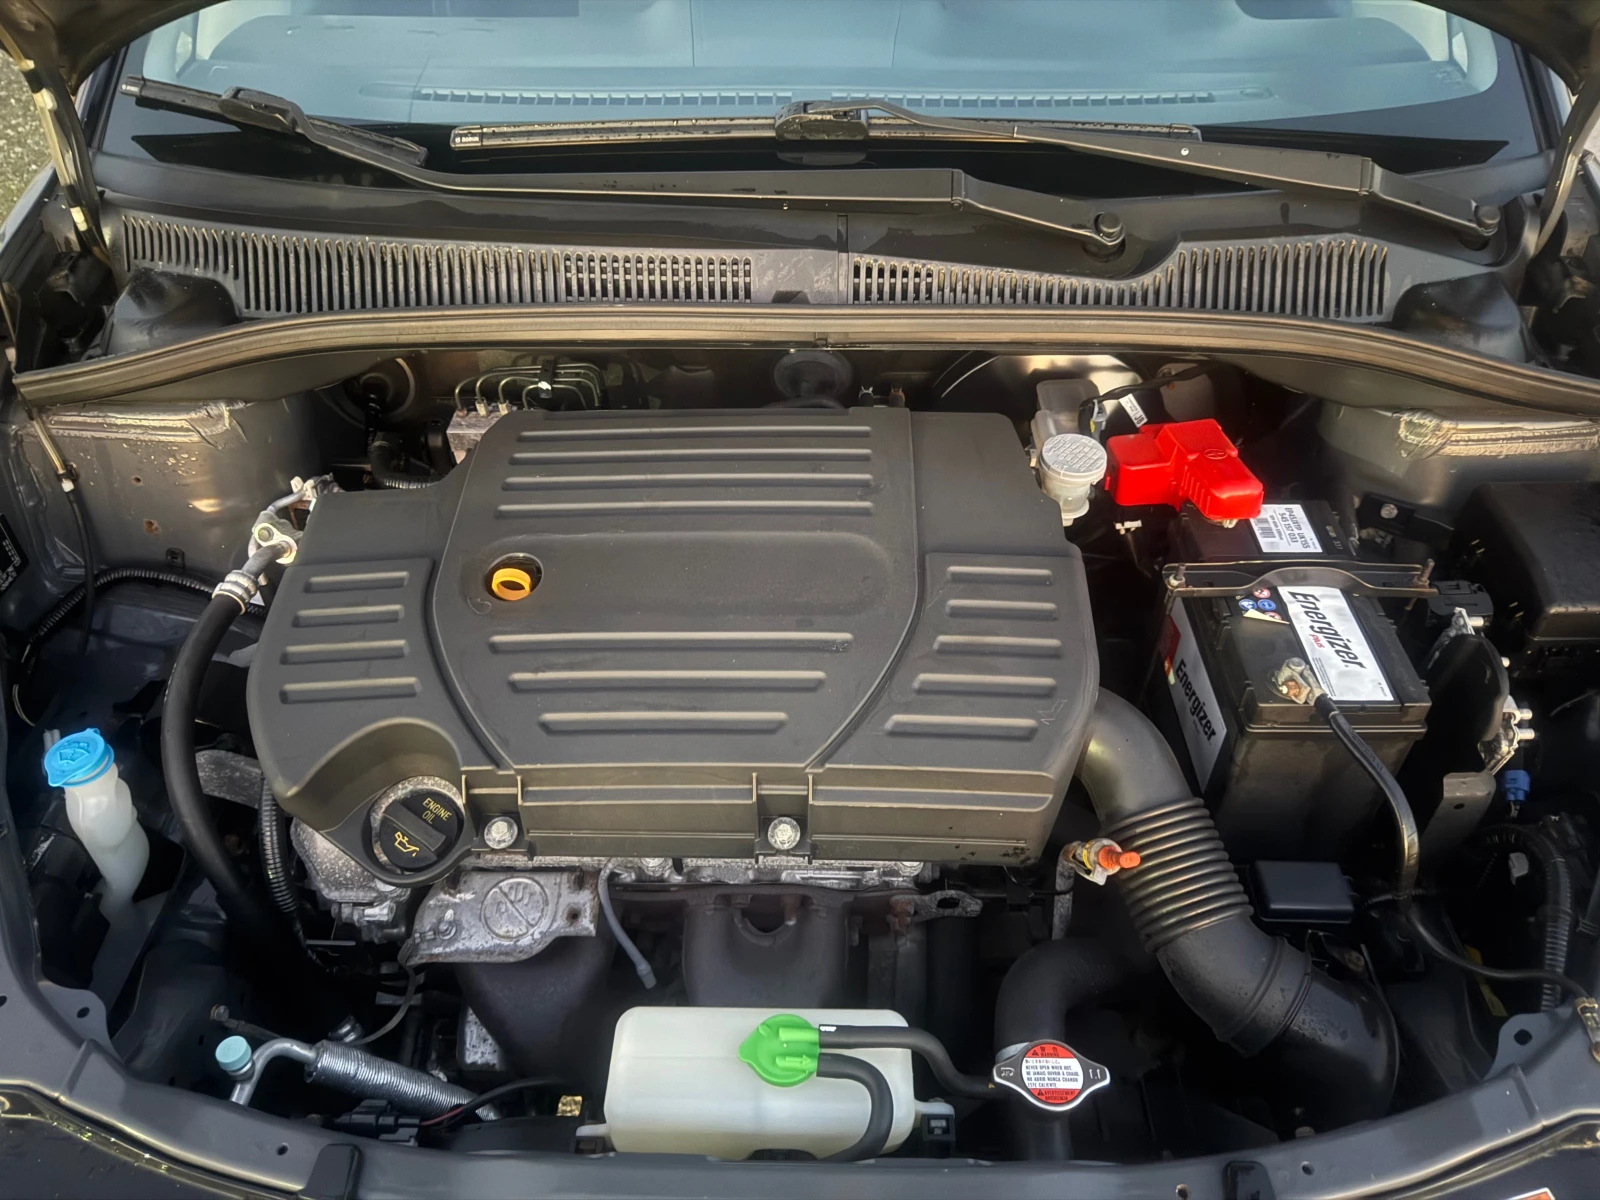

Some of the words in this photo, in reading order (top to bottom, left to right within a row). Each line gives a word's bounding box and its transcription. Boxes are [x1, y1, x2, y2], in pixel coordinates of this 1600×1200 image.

[1288, 591, 1367, 669] Energizer
[1175, 658, 1217, 742] Energizer
[422, 797, 452, 822] ENGINE
[422, 810, 436, 825] OIL
